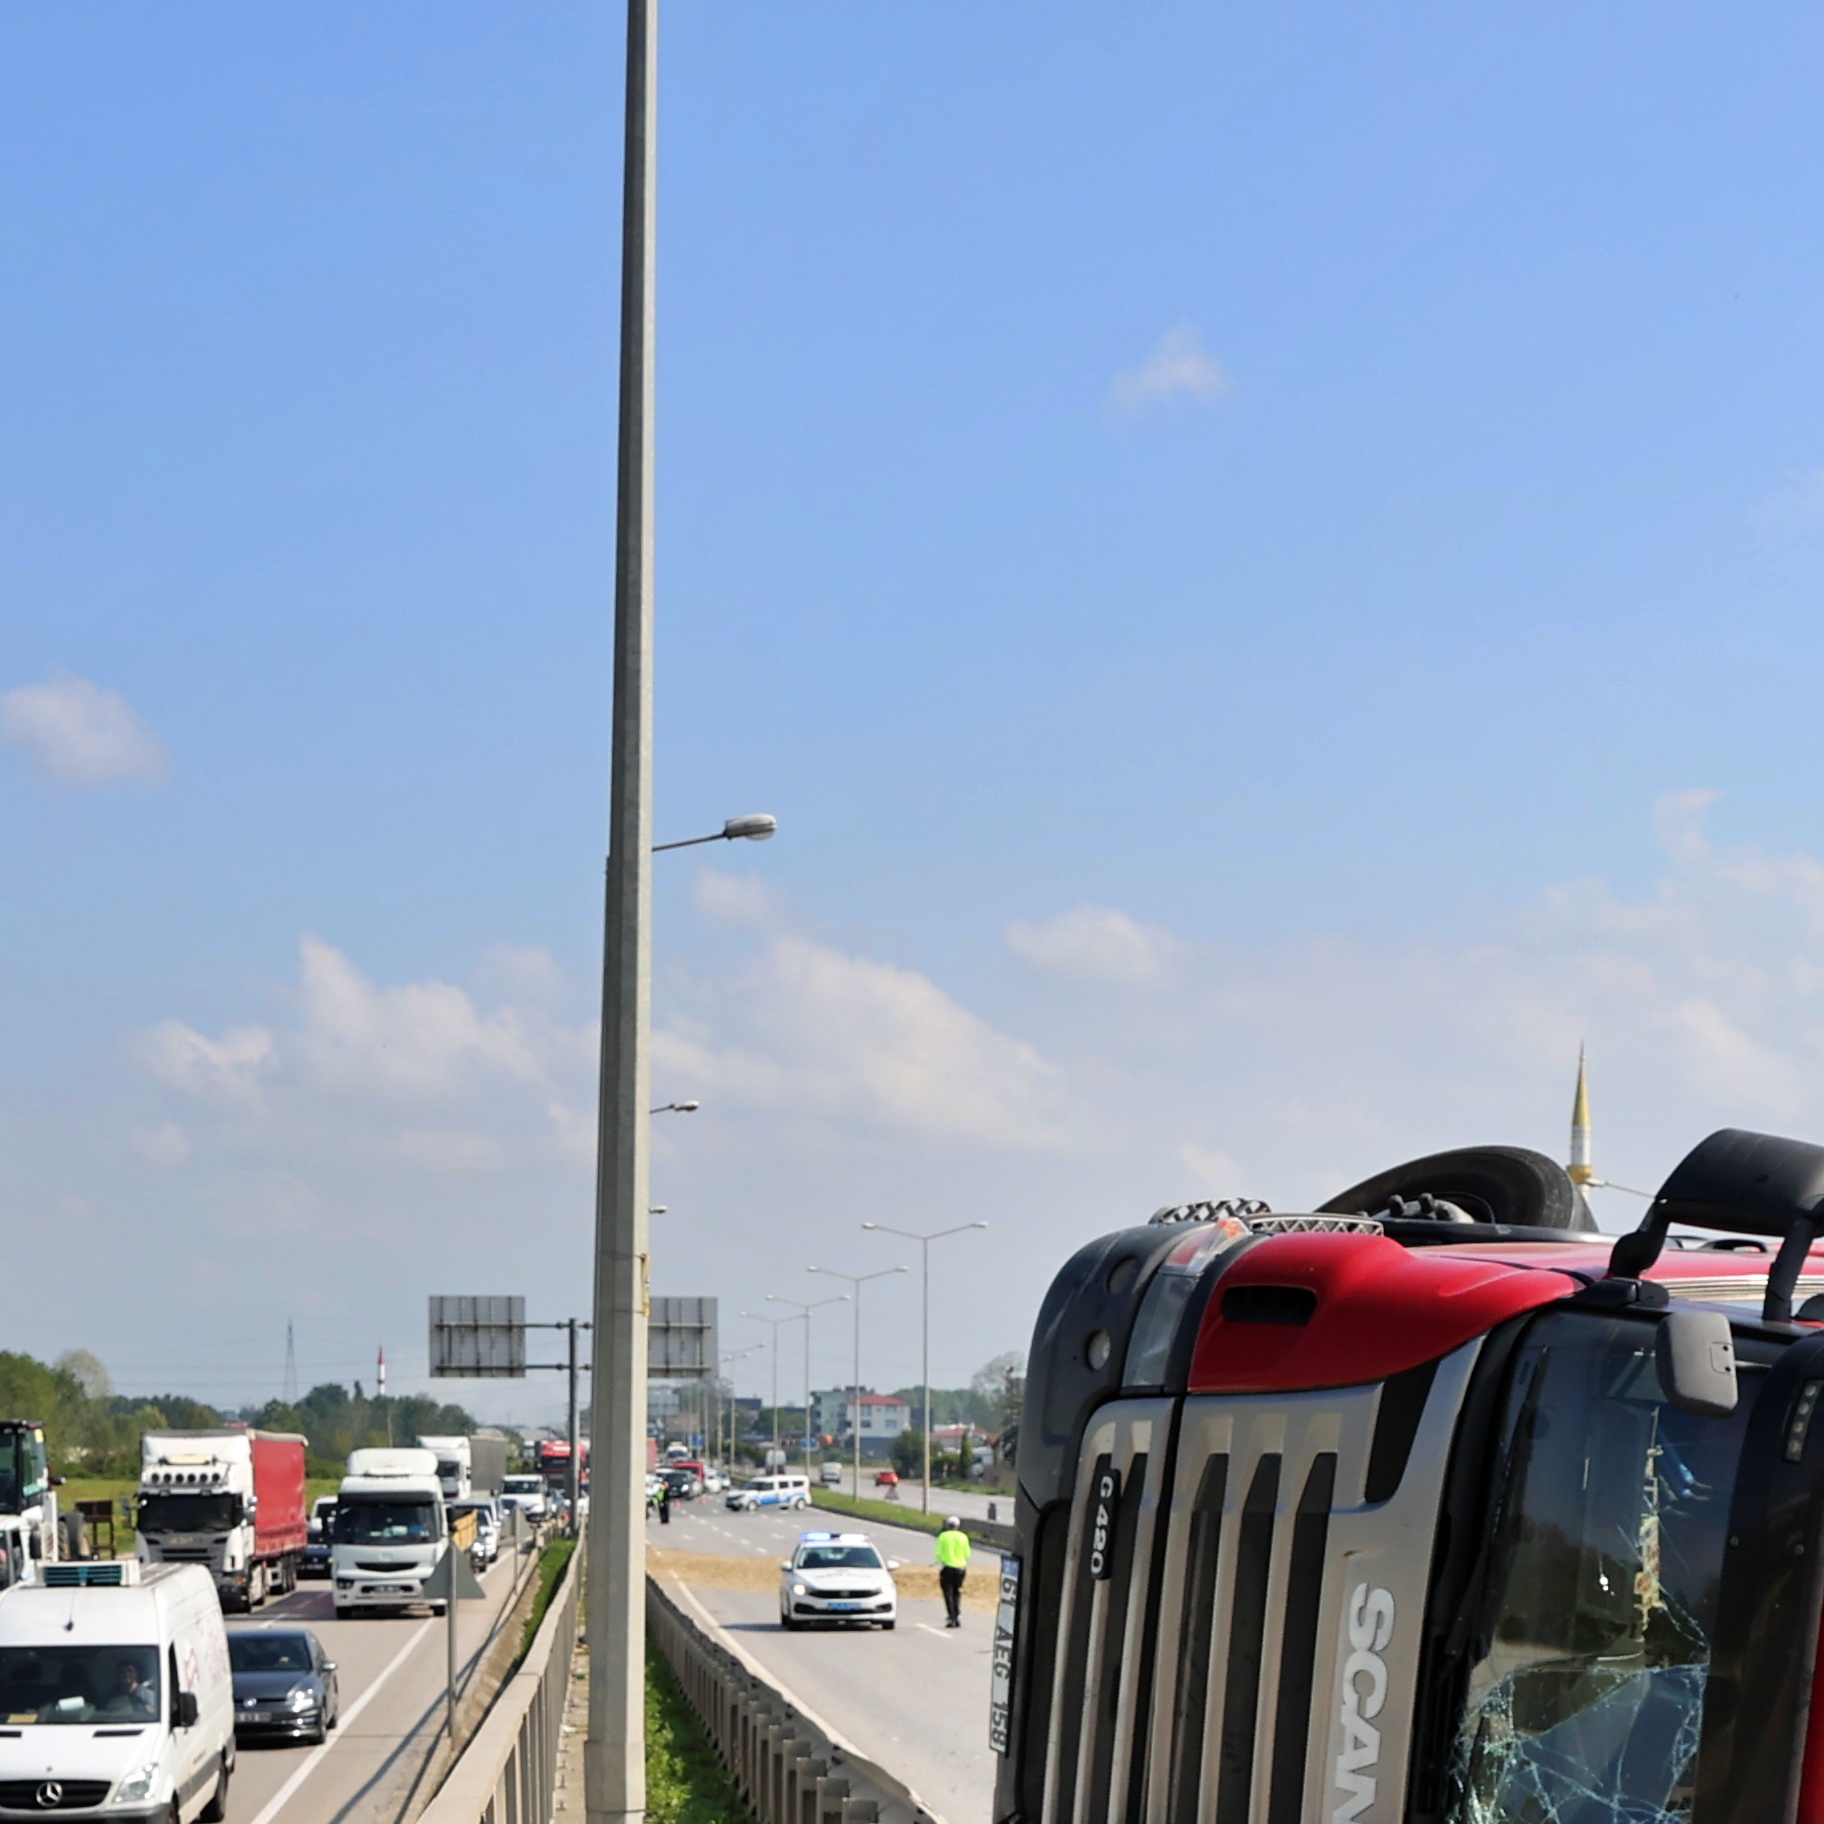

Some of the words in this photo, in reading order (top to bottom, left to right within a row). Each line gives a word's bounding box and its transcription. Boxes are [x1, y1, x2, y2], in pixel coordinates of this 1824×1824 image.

[1100, 1475, 1114, 1498] G
[1090, 1503, 1109, 1574] 420
[1001, 1577, 1017, 1607] 61
[994, 1624, 1014, 1681] AEG
[990, 1701, 1009, 1747] 158
